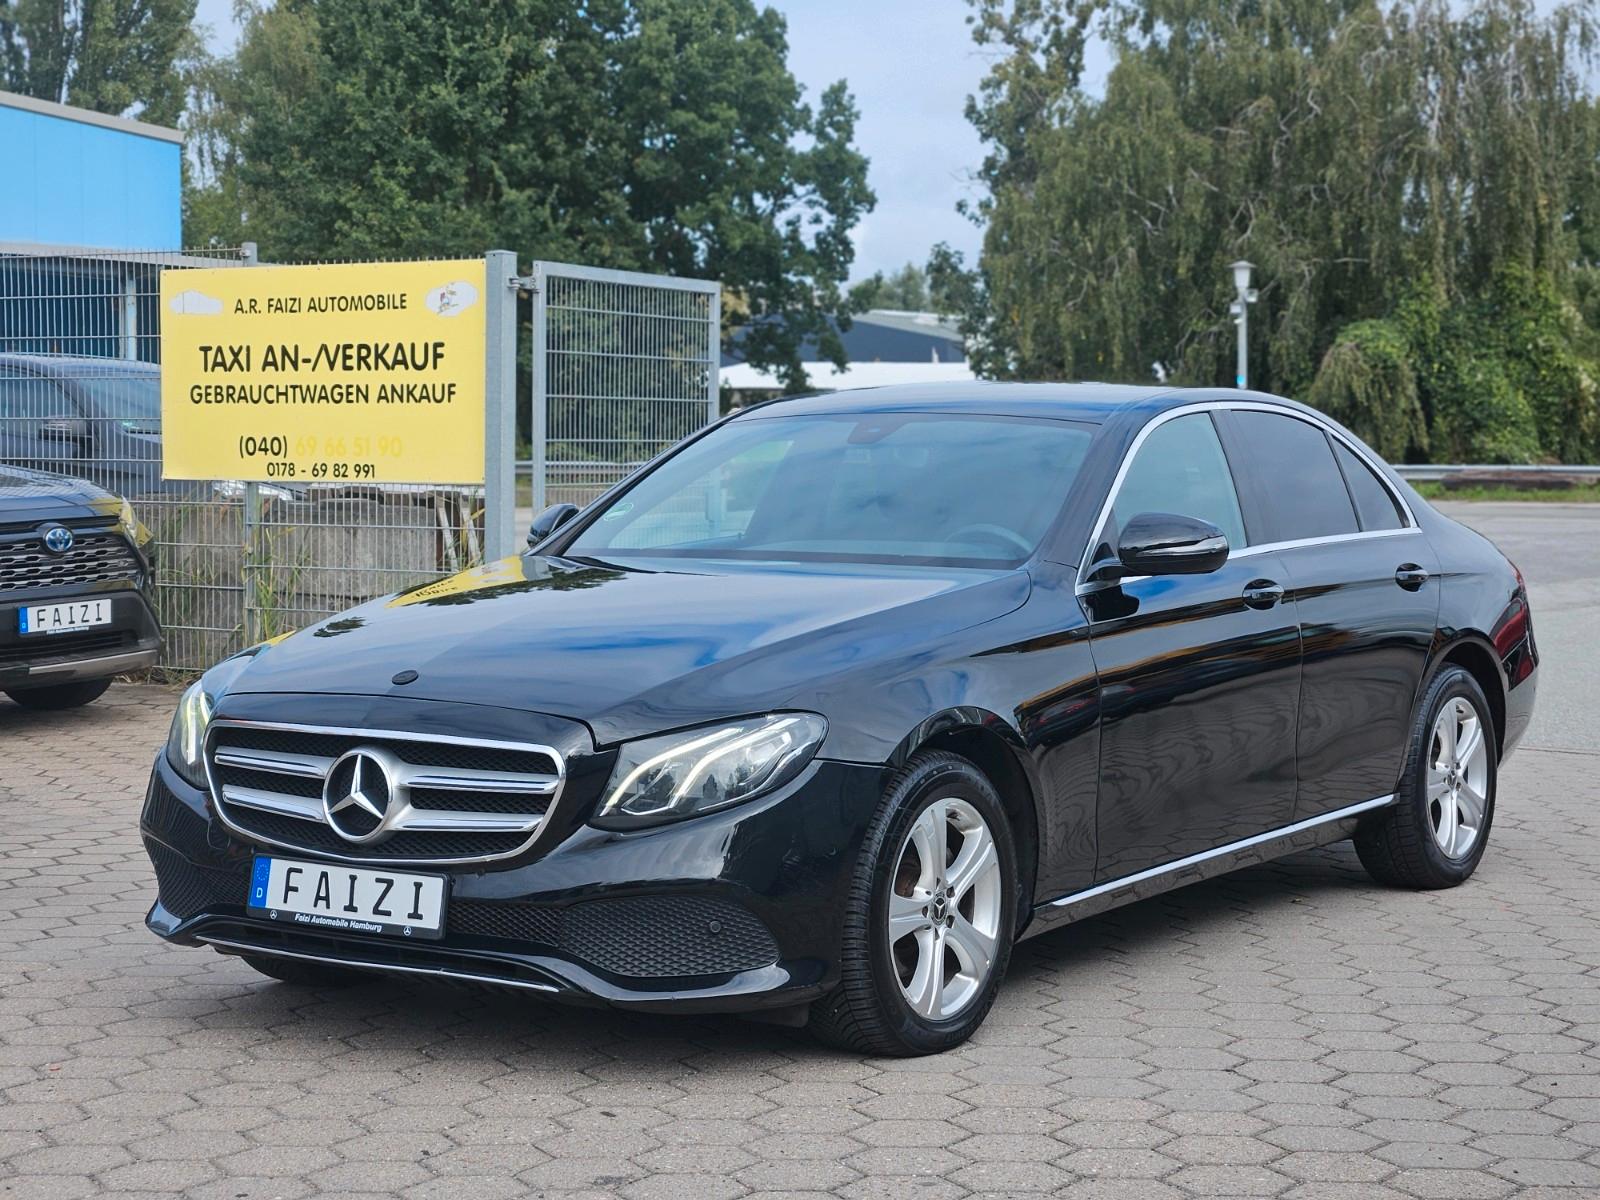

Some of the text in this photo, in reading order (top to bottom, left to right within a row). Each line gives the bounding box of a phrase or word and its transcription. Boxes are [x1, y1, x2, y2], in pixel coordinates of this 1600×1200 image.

[234, 293, 408, 315] A.R. FAIZI AUTOMOBILE
[199, 342, 446, 373] TAXI AN-/VERKAUF
[190, 383, 457, 405] GEBRAUCHTWAGEN ANKAUF
[239, 435, 402, 459] (040) 69 66 51 90
[267, 462, 296, 477] 0178
[312, 463, 328, 478] 69
[333, 463, 349, 478] 82
[354, 464, 375, 478] 991
[37, 603, 102, 627] FAIZI
[256, 867, 423, 920] D FAIZI
[295, 913, 382, 932] Faizi Automobile Hamburg
